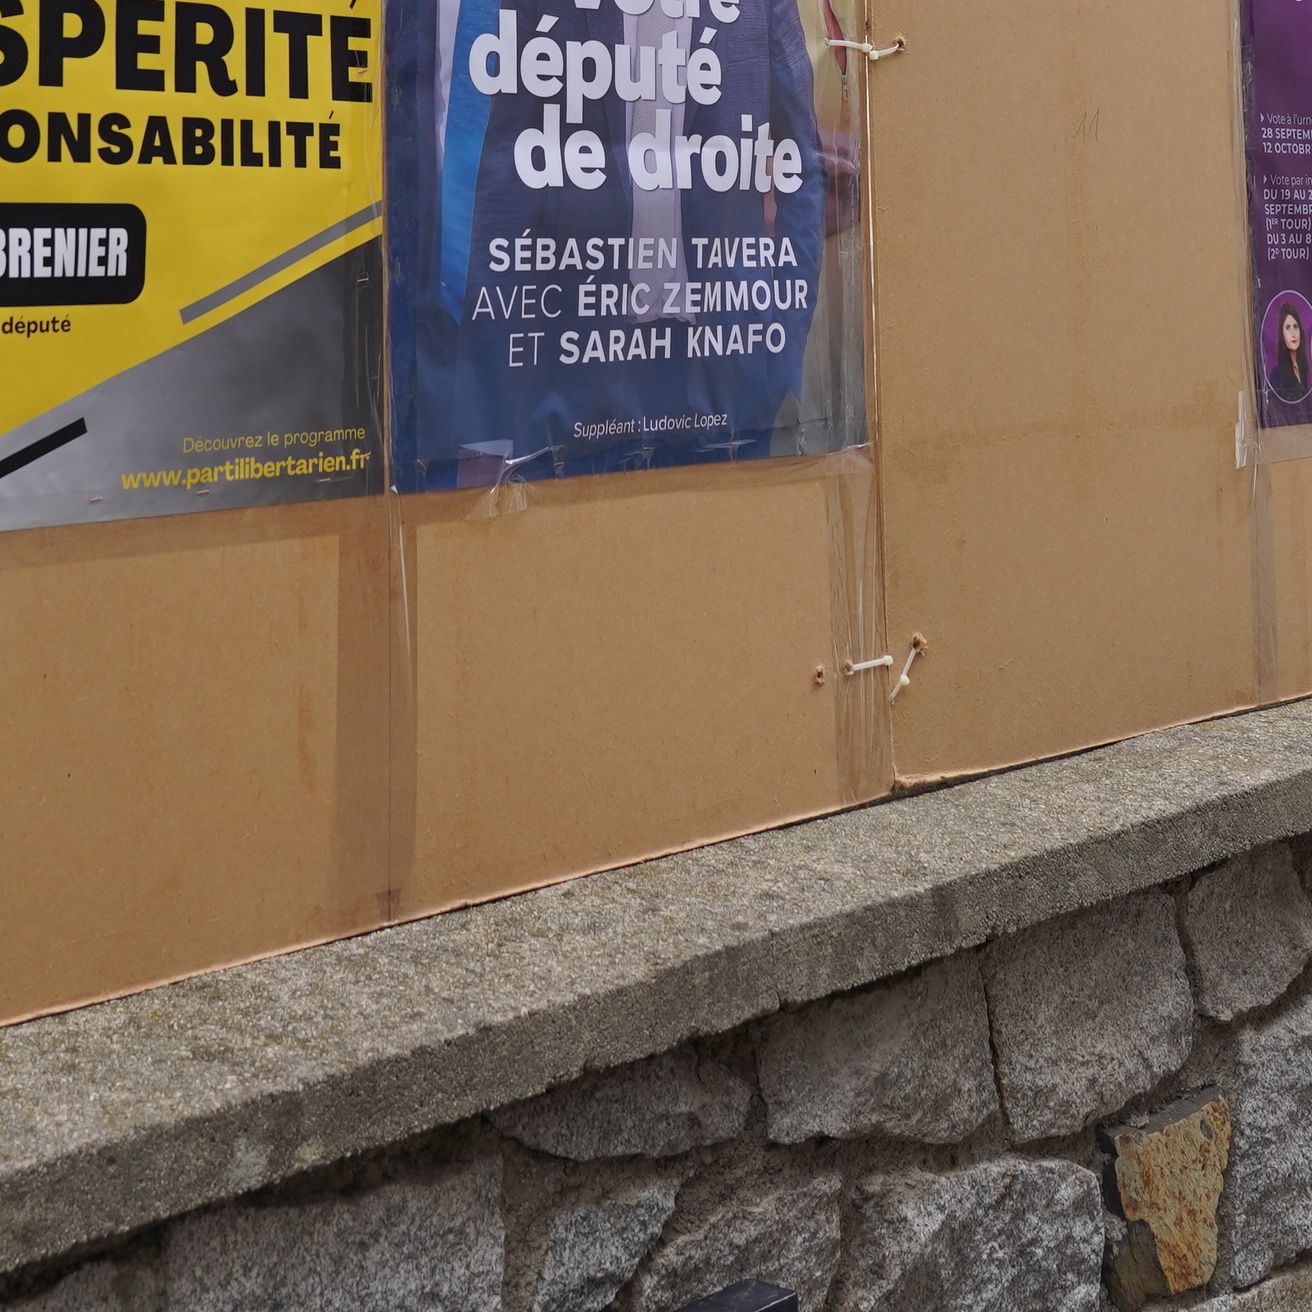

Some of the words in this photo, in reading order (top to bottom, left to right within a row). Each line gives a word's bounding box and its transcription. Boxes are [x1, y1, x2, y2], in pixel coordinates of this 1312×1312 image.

[469, 8, 722, 124] député
[1261, 128, 1273, 138] 28
[514, 103, 607, 189] de
[628, 108, 804, 194] droite
[1263, 142, 1272, 153] 12
[1281, 219, 1311, 230] TOUR)
[488, 228, 678, 273] SÉBASTIEN
[692, 236, 798, 268] TAVERA
[1281, 248, 1310, 260] TOUR)
[472, 284, 562, 321] AVEC
[577, 275, 650, 317] ÉRIC
[662, 279, 808, 314] ZEMMOUR
[1, 313, 71, 338] député
[509, 332, 544, 367] ET
[559, 327, 671, 365] SARAH
[687, 321, 787, 359] KNAFO
[643, 414, 692, 433] Ludovic
[694, 411, 728, 430] Lopez
[183, 434, 263, 453] Découvrez
[266, 431, 279, 446] le
[283, 427, 365, 449] programme
[121, 449, 370, 490] www.partilibertarien.fr
